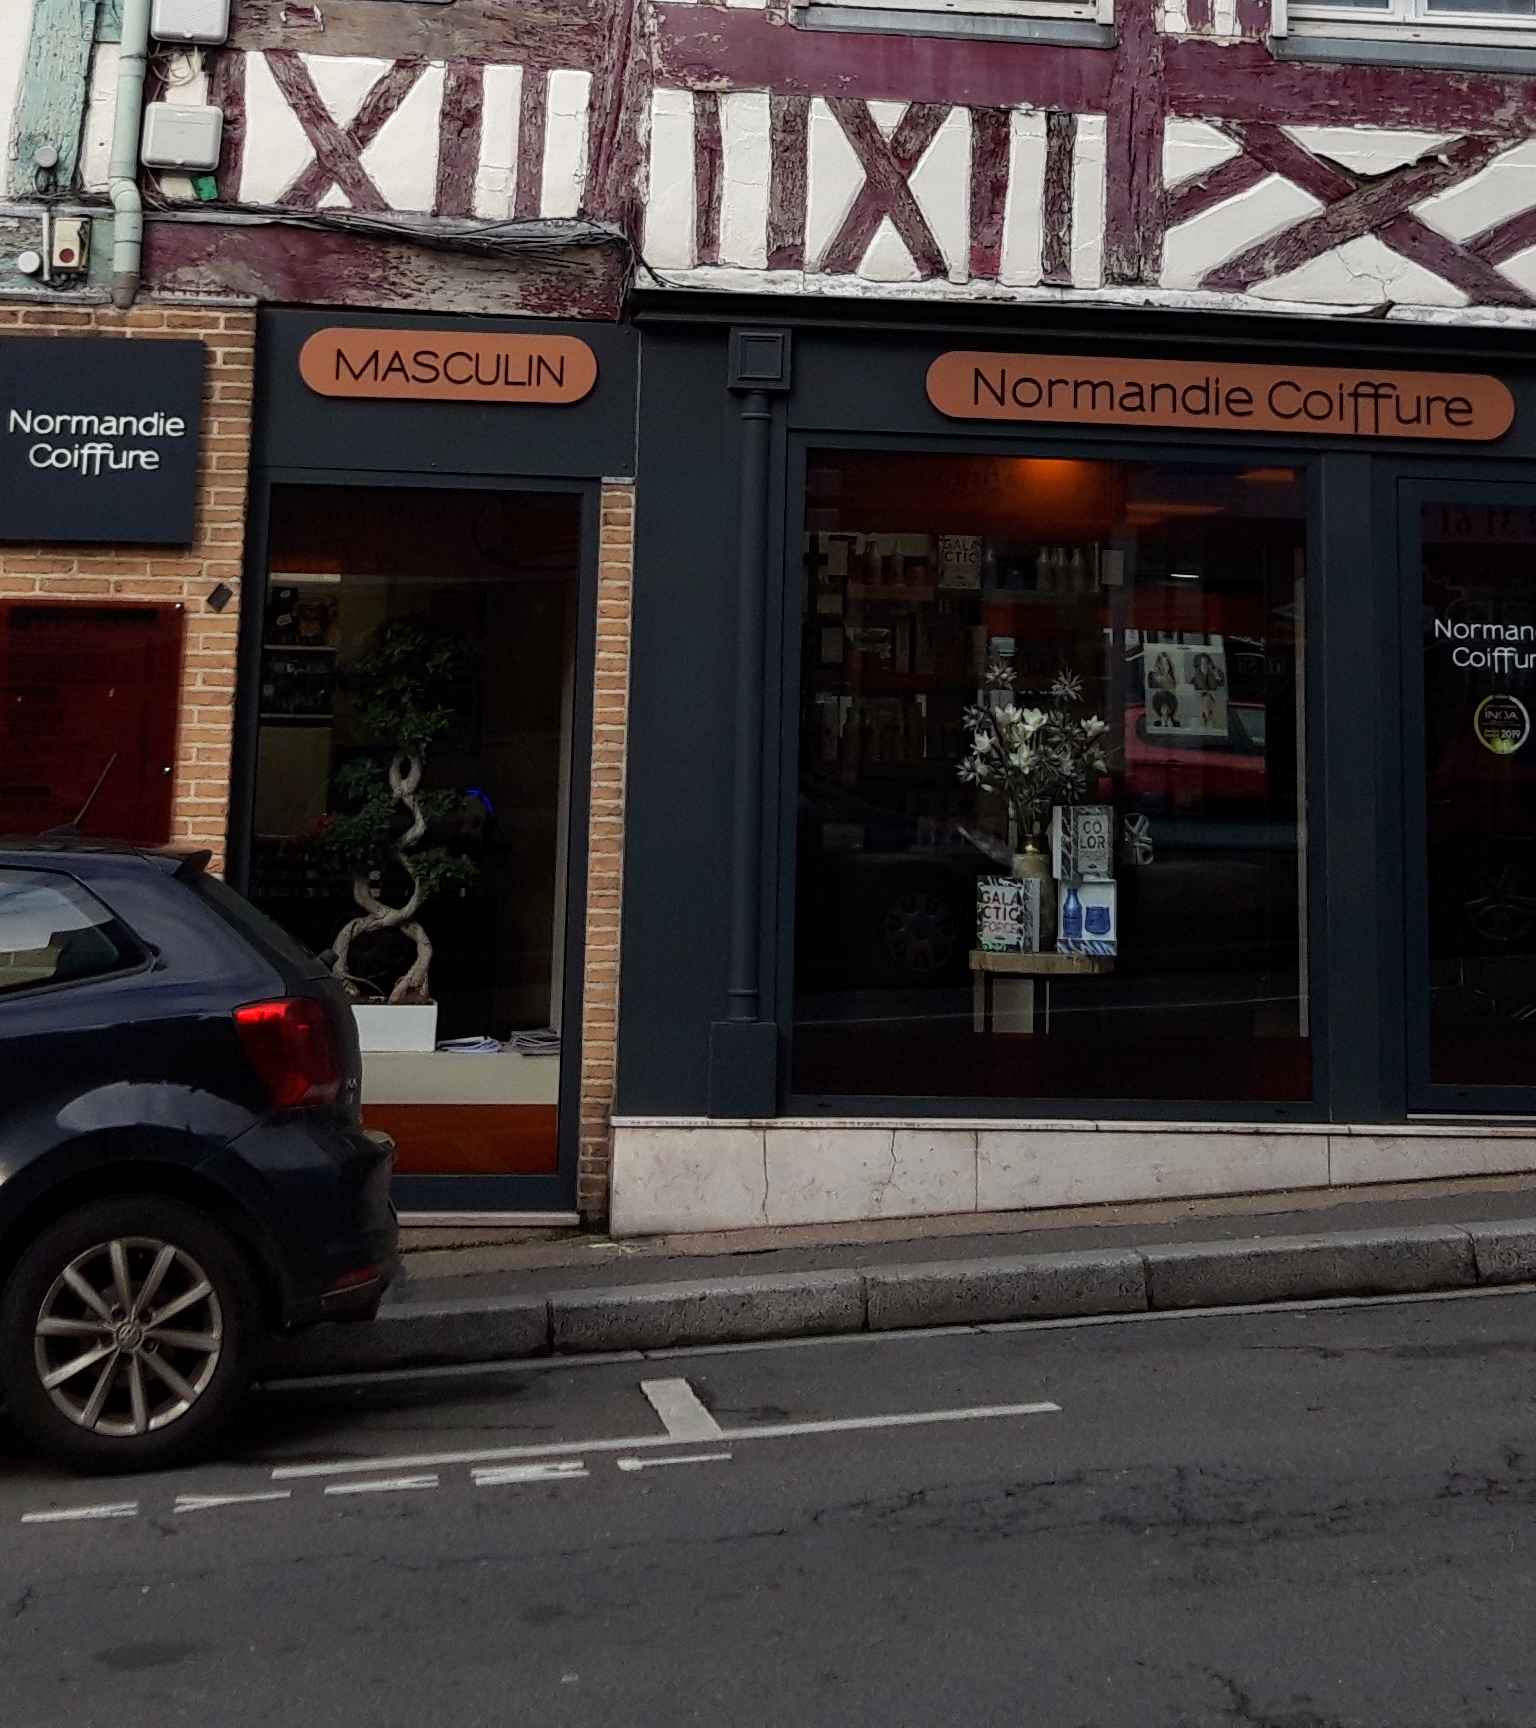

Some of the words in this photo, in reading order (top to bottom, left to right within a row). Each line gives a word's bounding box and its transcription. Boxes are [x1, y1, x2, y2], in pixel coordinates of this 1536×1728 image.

[335, 348, 565, 388] MASCULIN
[972, 366, 1255, 417] Normandie
[1266, 379, 1474, 434] Coiffure
[8, 408, 186, 438] Normandie
[28, 441, 161, 476] Coiffure
[1080, 835, 1105, 849] LOR
[1083, 820, 1102, 834] CO
[983, 906, 1019, 921] CTIC
